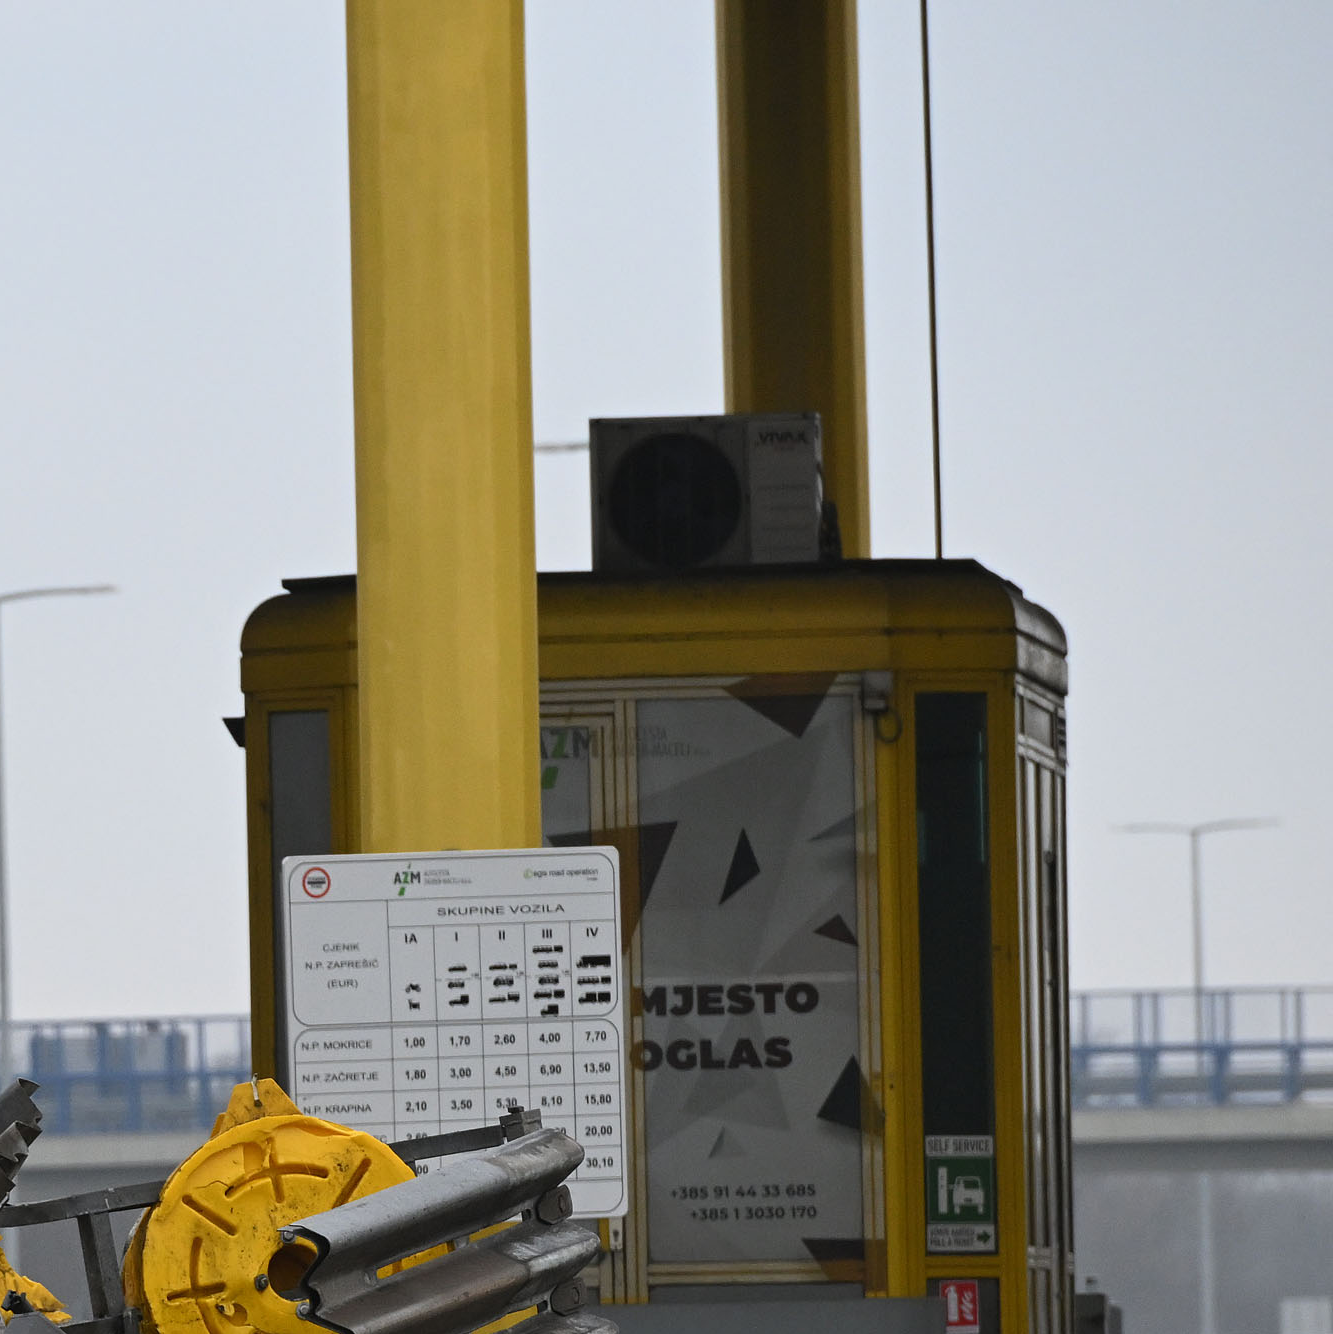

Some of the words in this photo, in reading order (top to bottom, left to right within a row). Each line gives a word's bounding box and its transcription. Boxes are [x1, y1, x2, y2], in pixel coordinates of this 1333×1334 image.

[438, 906, 504, 916] SKUPINE
[510, 904, 564, 914] VOZILA
[405, 934, 417, 943] IA
[587, 928, 598, 937] IV
[323, 943, 359, 952] CJENIK
[328, 979, 358, 989] (EUR)
[631, 982, 819, 1016] MJESTO
[324, 1040, 371, 1049] MOKRICE
[405, 1037, 425, 1048] 1,00
[450, 1036, 470, 1046] 1,70
[495, 1034, 515, 1044] 2,60
[539, 1033, 560, 1043] 4,00
[586, 1031, 606, 1042] 7,70
[630, 1036, 793, 1071] OGLAS
[406, 1070, 426, 1080] 1,80
[451, 1068, 471, 1079] 3,00
[495, 1066, 516, 1077] 4,50
[540, 1064, 561, 1075] 6,90
[584, 1062, 610, 1073] 13,50
[326, 1104, 371, 1113] KRAPINA
[406, 1101, 427, 1112] 2,10
[451, 1100, 472, 1110] 3,50
[542, 1096, 562, 1107] 8,10
[585, 1094, 611, 1105] 15,80
[585, 1126, 612, 1136] 20,00
[927, 1139, 949, 1153] SELF
[953, 1138, 989, 1152] SERVICE
[586, 1157, 613, 1167] 30,10
[671, 1187, 709, 1199] +385
[714, 1185, 729, 1199] 91
[735, 1186, 757, 1198] 44
[762, 1185, 780, 1198] 33
[786, 1184, 816, 1197] 685
[691, 1208, 729, 1221] +385
[734, 1208, 739, 1219] 1
[745, 1207, 785, 1219] 3030
[791, 1206, 817, 1218] 170
